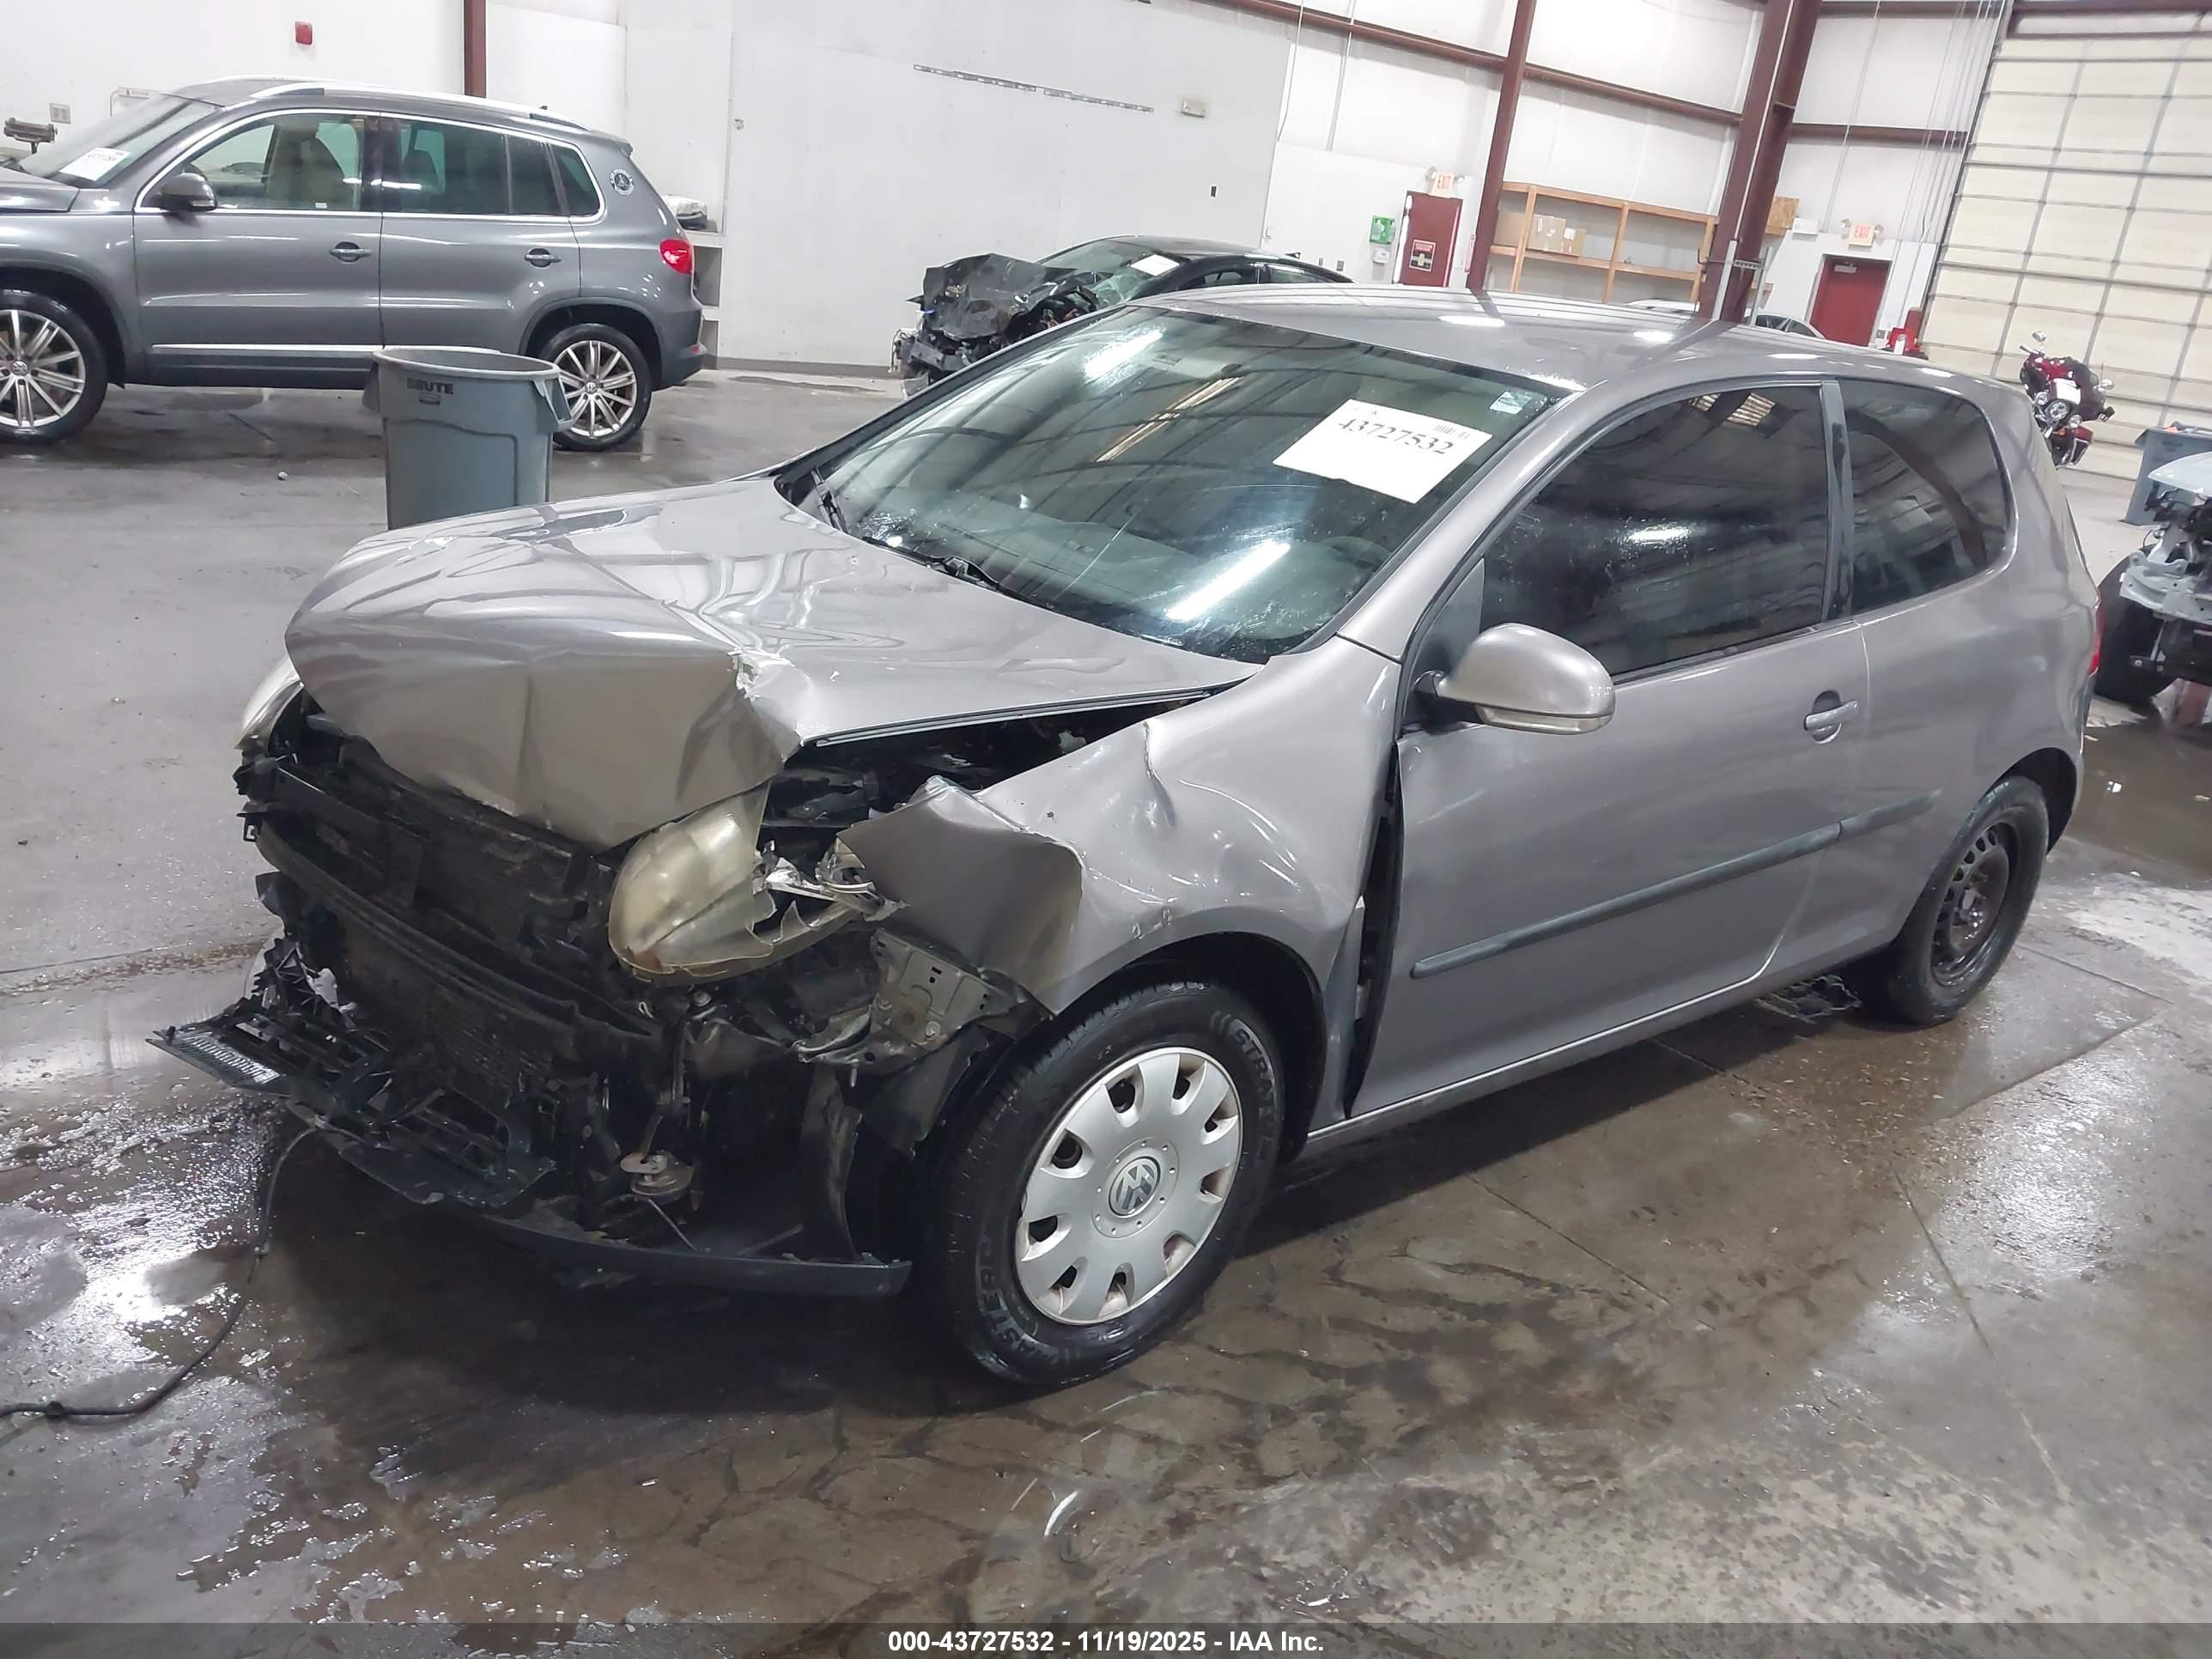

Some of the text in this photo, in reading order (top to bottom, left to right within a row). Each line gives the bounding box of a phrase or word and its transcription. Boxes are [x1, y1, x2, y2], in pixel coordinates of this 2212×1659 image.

[1437, 173, 1451, 189] EXIT
[407, 378, 453, 394] BRUTE
[1338, 418, 1455, 454] 43727532
